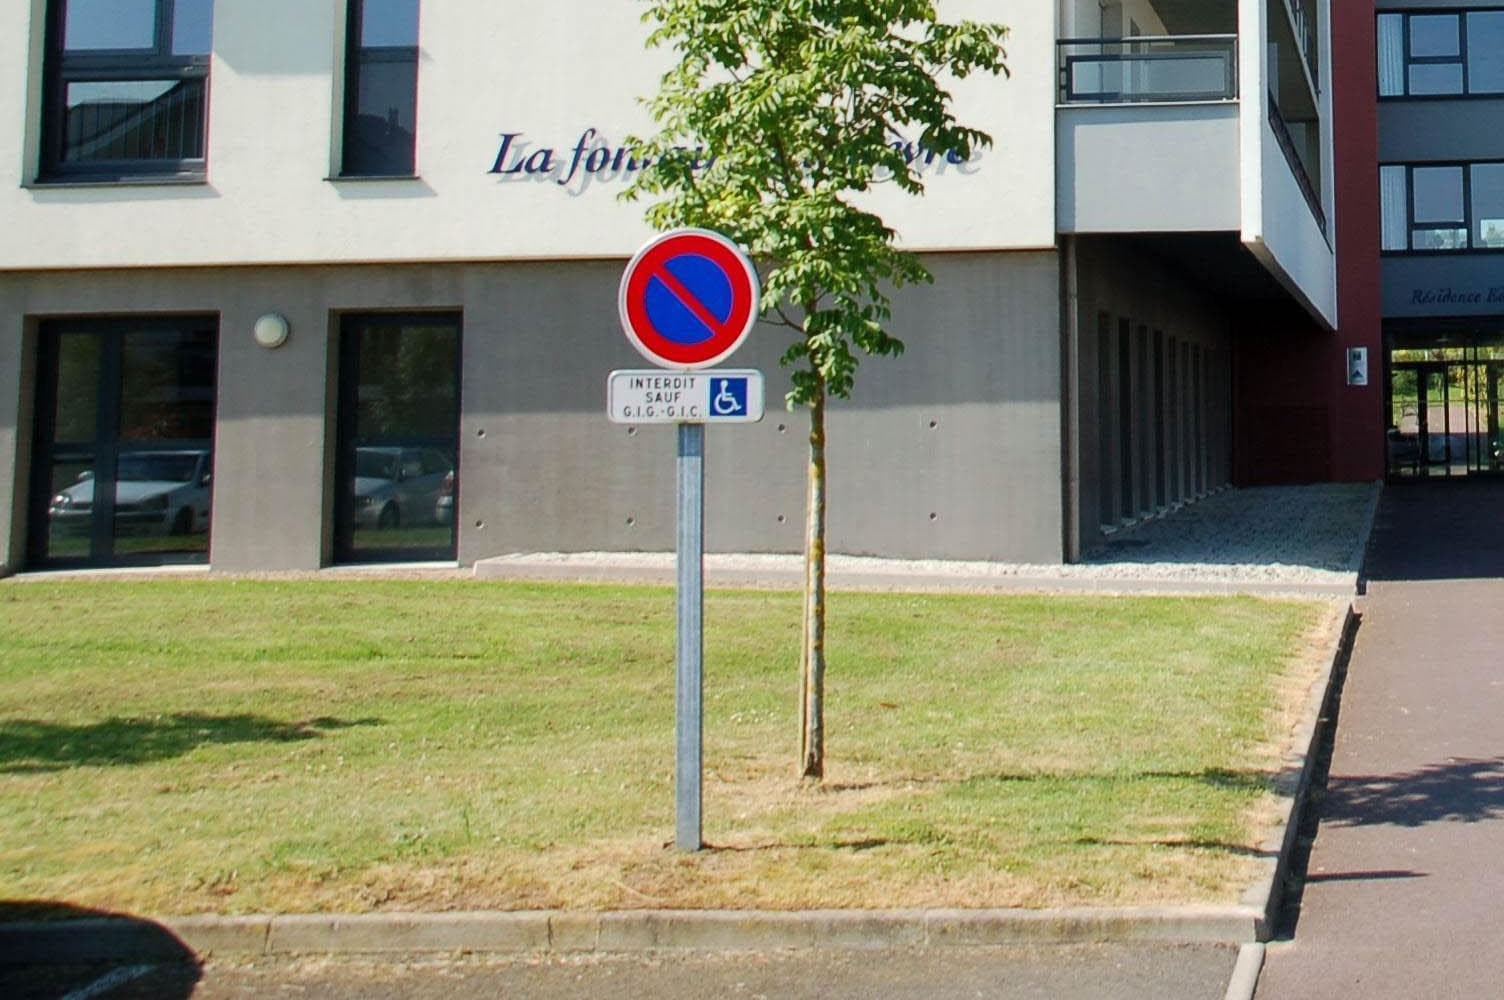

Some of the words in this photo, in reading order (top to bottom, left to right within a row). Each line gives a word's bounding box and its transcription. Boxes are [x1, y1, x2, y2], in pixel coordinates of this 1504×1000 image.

[486, 132, 554, 174] La
[630, 377, 696, 389] INTERDIT
[646, 391, 681, 403] SAUF
